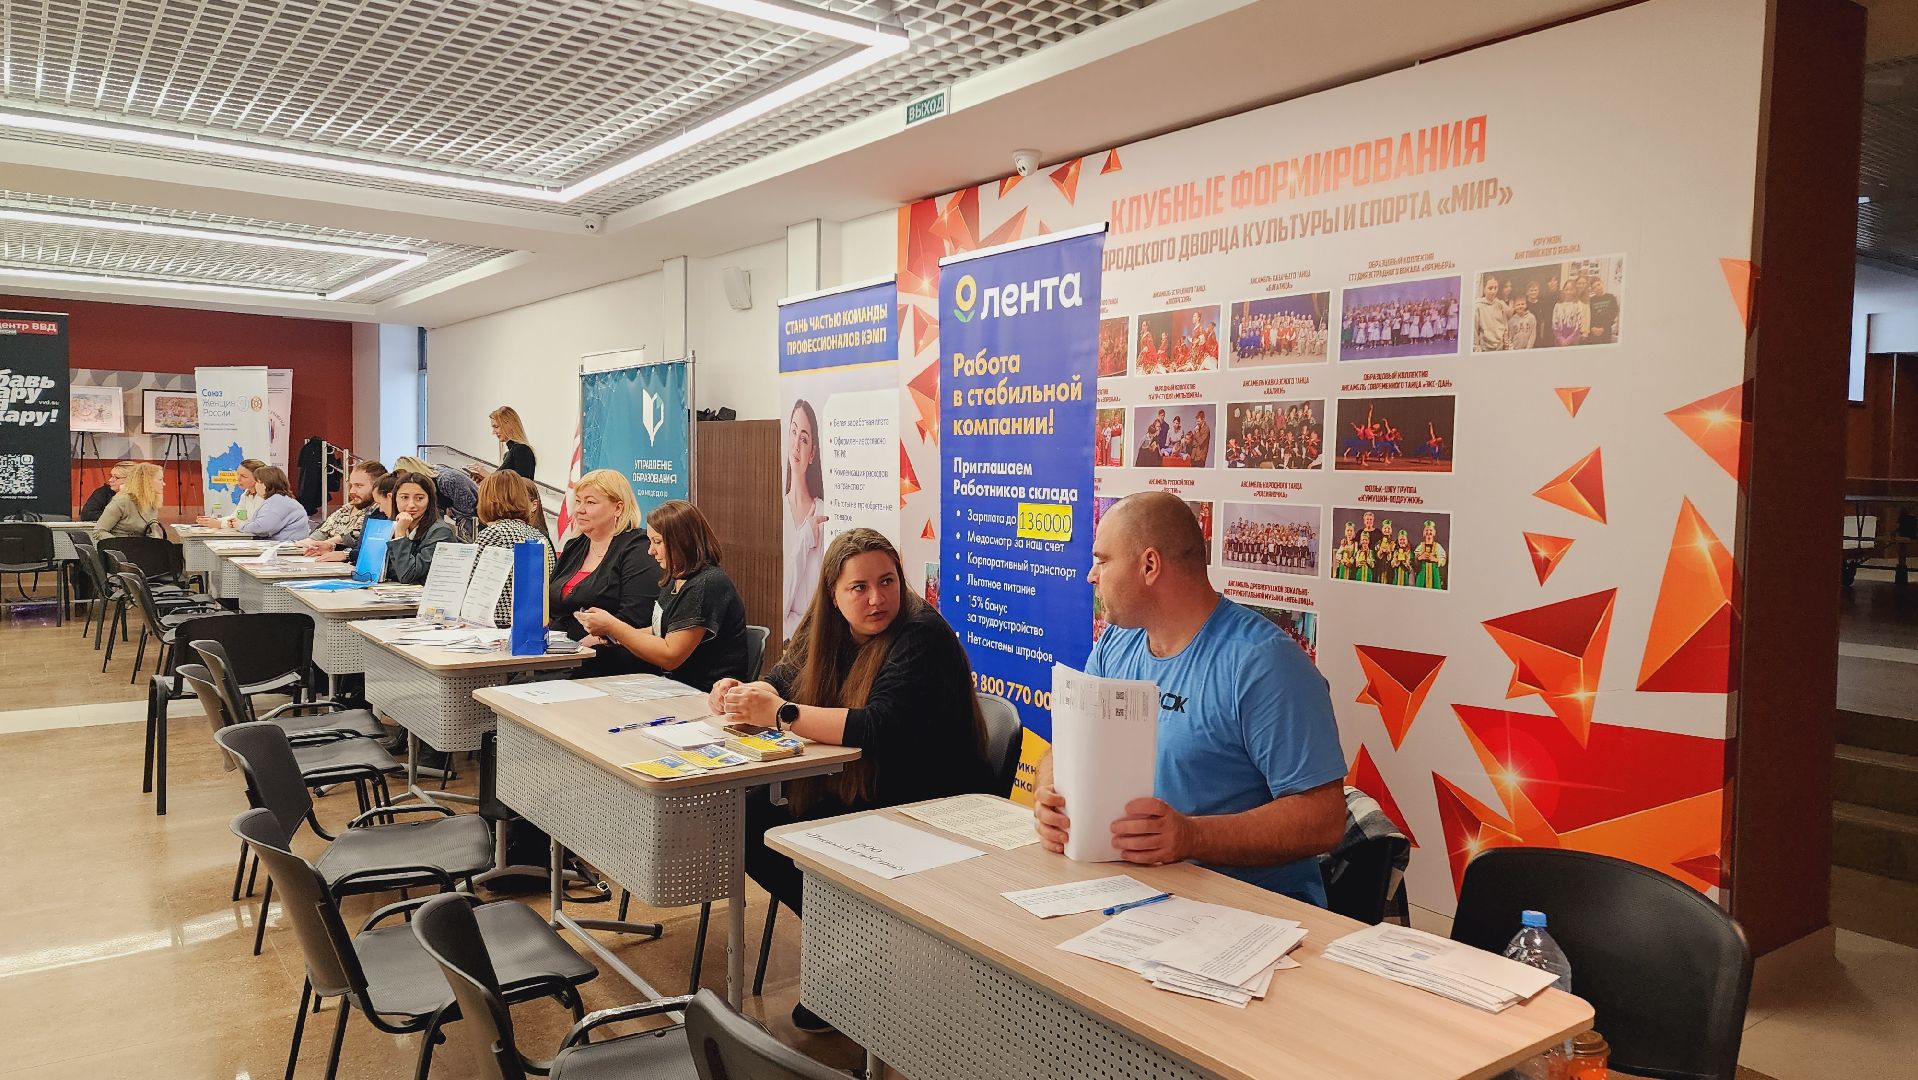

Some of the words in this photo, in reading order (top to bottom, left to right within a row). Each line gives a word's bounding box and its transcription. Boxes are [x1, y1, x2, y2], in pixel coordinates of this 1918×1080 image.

[909, 96, 943, 121] ВЫХОД
[1111, 175, 1226, 235] КЛУБНЫЕ
[1230, 114, 1488, 209] ФОРМИРОВАНИЯ
[1178, 225, 1240, 262] ДВОРЦА
[1242, 205, 1340, 247] КУЛЬТУРЫ
[1343, 203, 1357, 231] И
[1359, 190, 1432, 228] СПОРТА
[1437, 177, 1514, 215] «МИР»
[980, 271, 1083, 321] лента
[31, 322, 57, 332] ВВД
[785, 318, 809, 335] СТАНЬ
[810, 312, 841, 329] ЧАСТЬЮ
[842, 303, 888, 325] КОМАНДЫ
[786, 331, 860, 356] ПРОФЕССИОНАЛОВ
[861, 327, 887, 346] КЭМП
[953, 348, 1021, 378] Работа
[201, 389, 223, 398] Союз
[953, 389, 963, 407] в
[967, 374, 1083, 407] стабильной
[953, 408, 1054, 436] компании!
[634, 459, 673, 471] УПРАВЛЕНИЕ
[953, 456, 1033, 478] Приглашаем
[632, 472, 677, 484] ОБРАЗОВАНИЯ
[953, 479, 1026, 499] Работников
[1028, 487, 1078, 504] склада
[967, 508, 1005, 526] Зарплата
[1006, 515, 1017, 526] до
[1019, 511, 1072, 534] 136000
[967, 531, 1012, 551] Медосмотр
[1014, 540, 1024, 548] за
[1026, 540, 1042, 551] наш
[1045, 542, 1065, 553] счет
[967, 551, 1029, 572] Корпоративный
[1030, 563, 1077, 581] транспорт
[966, 573, 1002, 590] Льготное
[1003, 582, 1036, 596] питание
[984, 598, 1008, 616] бонус
[967, 613, 977, 623] за
[978, 615, 1044, 637] трудоустройство
[967, 630, 981, 646] Нет
[981, 637, 1014, 653] системы
[1015, 646, 1053, 664] штрафов
[980, 674, 1004, 697] 800
[1006, 681, 1031, 705] 770
[1158, 692, 1190, 714] OK
